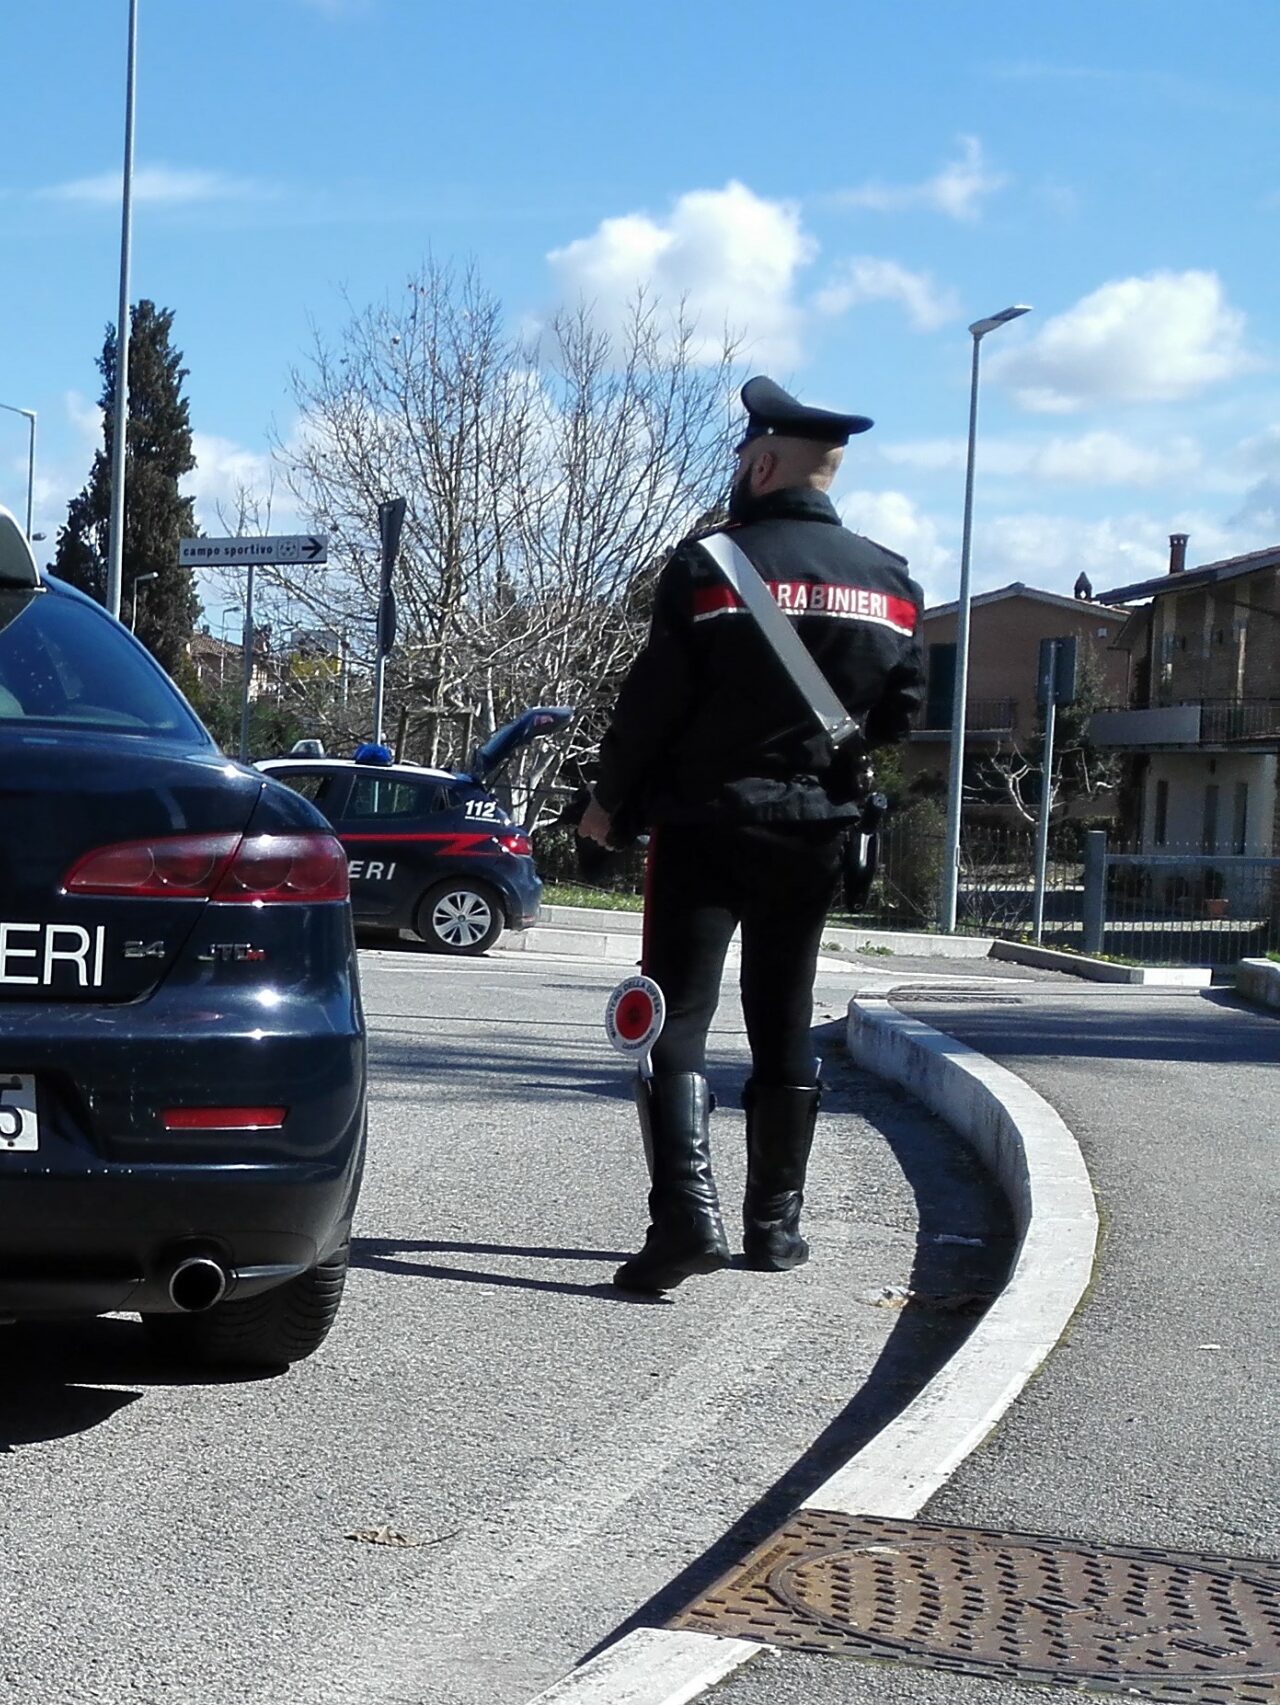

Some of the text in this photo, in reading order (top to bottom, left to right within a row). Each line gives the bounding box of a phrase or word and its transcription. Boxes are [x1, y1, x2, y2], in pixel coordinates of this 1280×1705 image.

[183, 543, 273, 559] campo sportivo
[766, 583, 888, 619] RABINIERI
[465, 799, 497, 818] 112
[348, 860, 396, 880] ERI
[623, 980, 646, 991] DELLA
